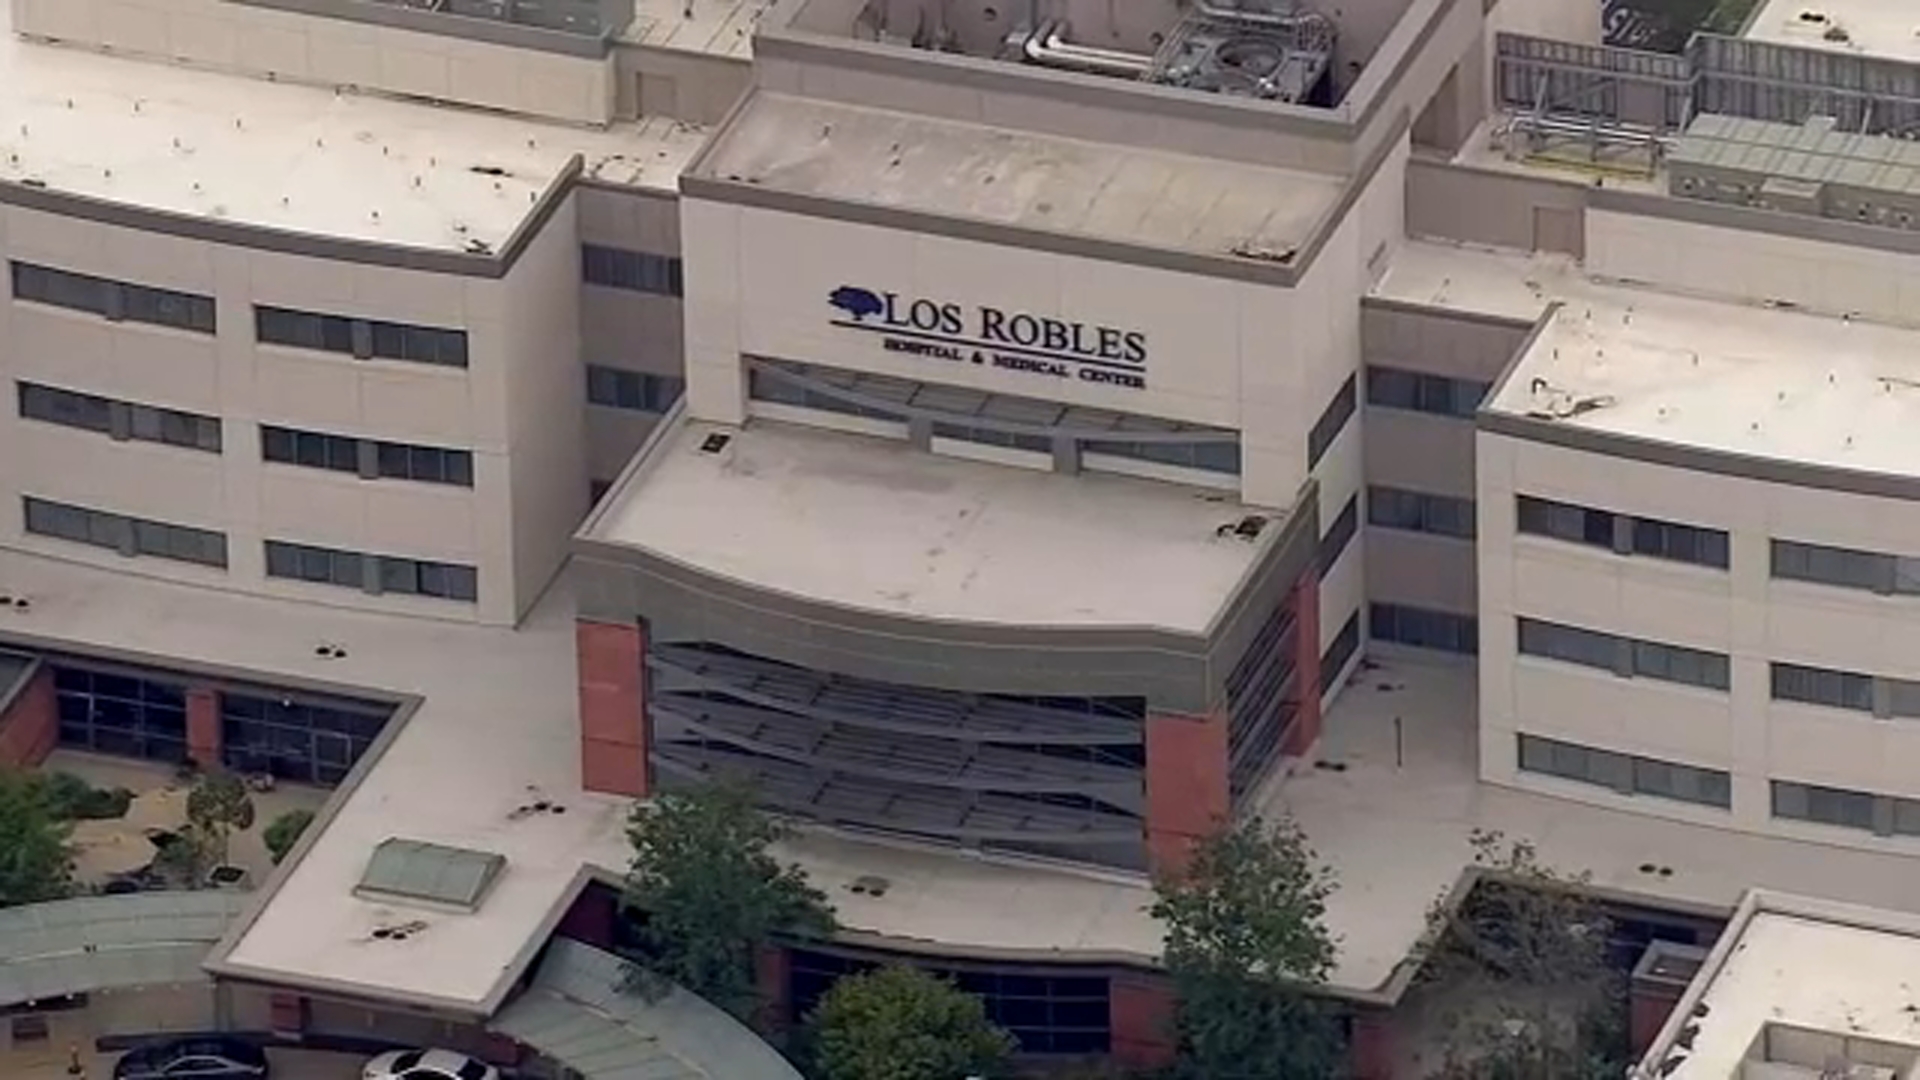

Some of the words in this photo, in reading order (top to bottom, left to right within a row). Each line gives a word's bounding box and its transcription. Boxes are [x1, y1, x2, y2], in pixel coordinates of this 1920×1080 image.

[883, 292, 962, 334] LOS
[979, 307, 1147, 363] ROBLES
[884, 338, 963, 361] HOSPITAL
[971, 351, 984, 364] &
[992, 354, 1070, 377] MEDICAL
[1078, 367, 1146, 390] CENTER
